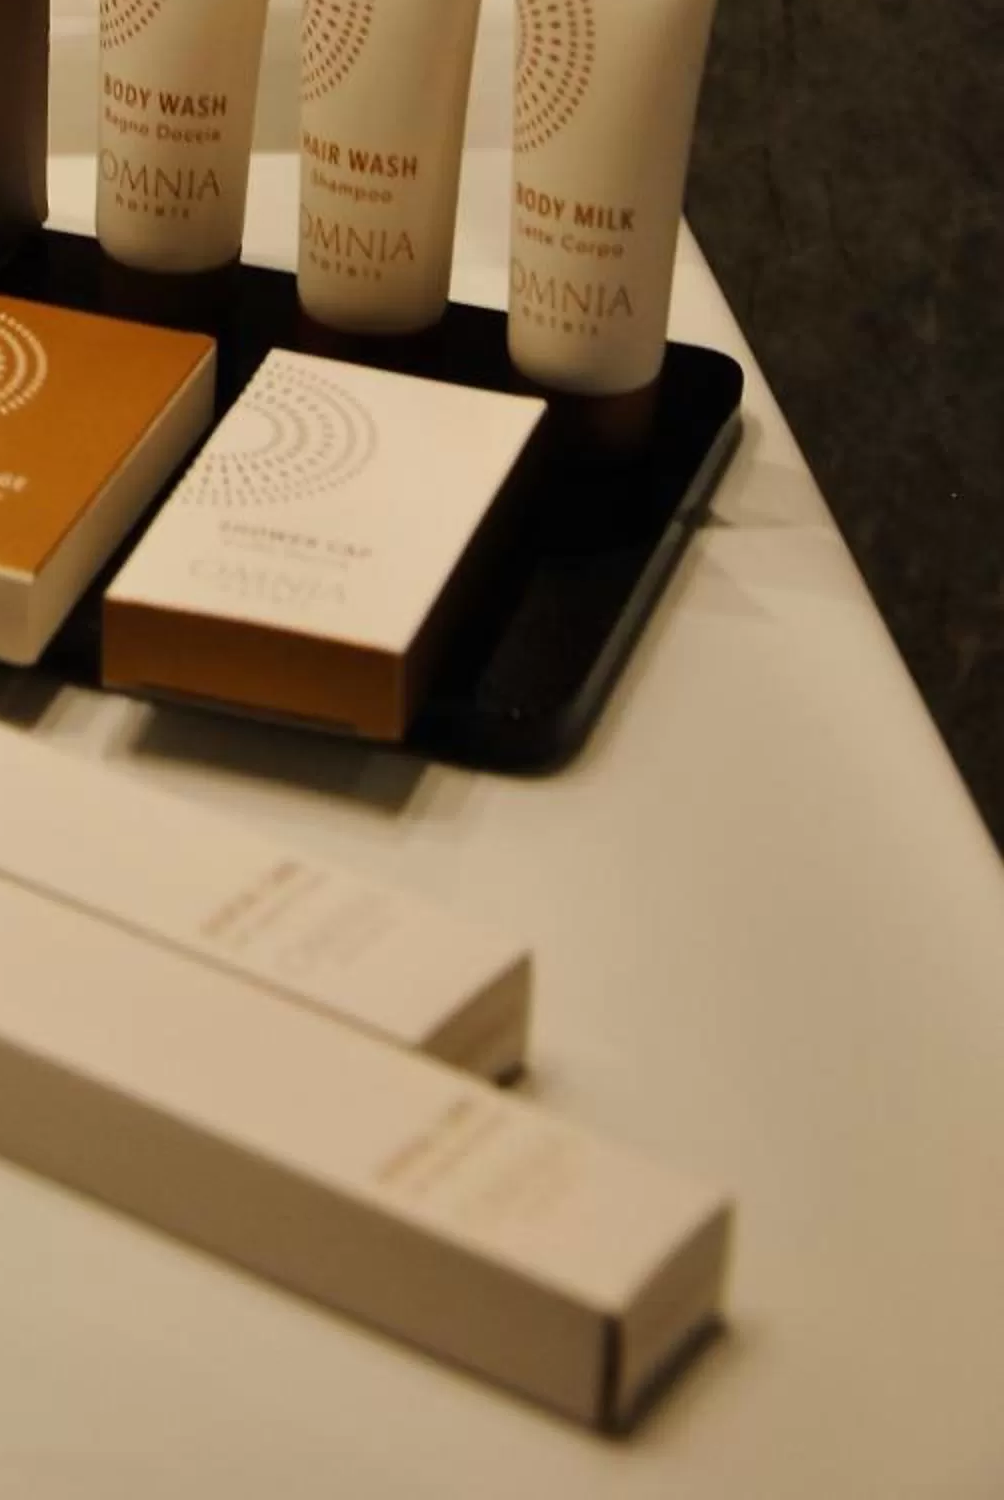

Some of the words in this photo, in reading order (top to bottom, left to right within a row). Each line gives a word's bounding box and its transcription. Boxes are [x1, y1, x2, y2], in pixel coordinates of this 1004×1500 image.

[103, 72, 152, 109] BODY
[159, 91, 228, 117] WASH
[99, 148, 221, 201] OMNIA
[302, 130, 341, 165] HAIR
[348, 148, 418, 180] WASH
[301, 201, 415, 263] OMNIA
[516, 181, 565, 220] BODY
[574, 202, 636, 232] MILK
[511, 256, 634, 318] OMNIA
